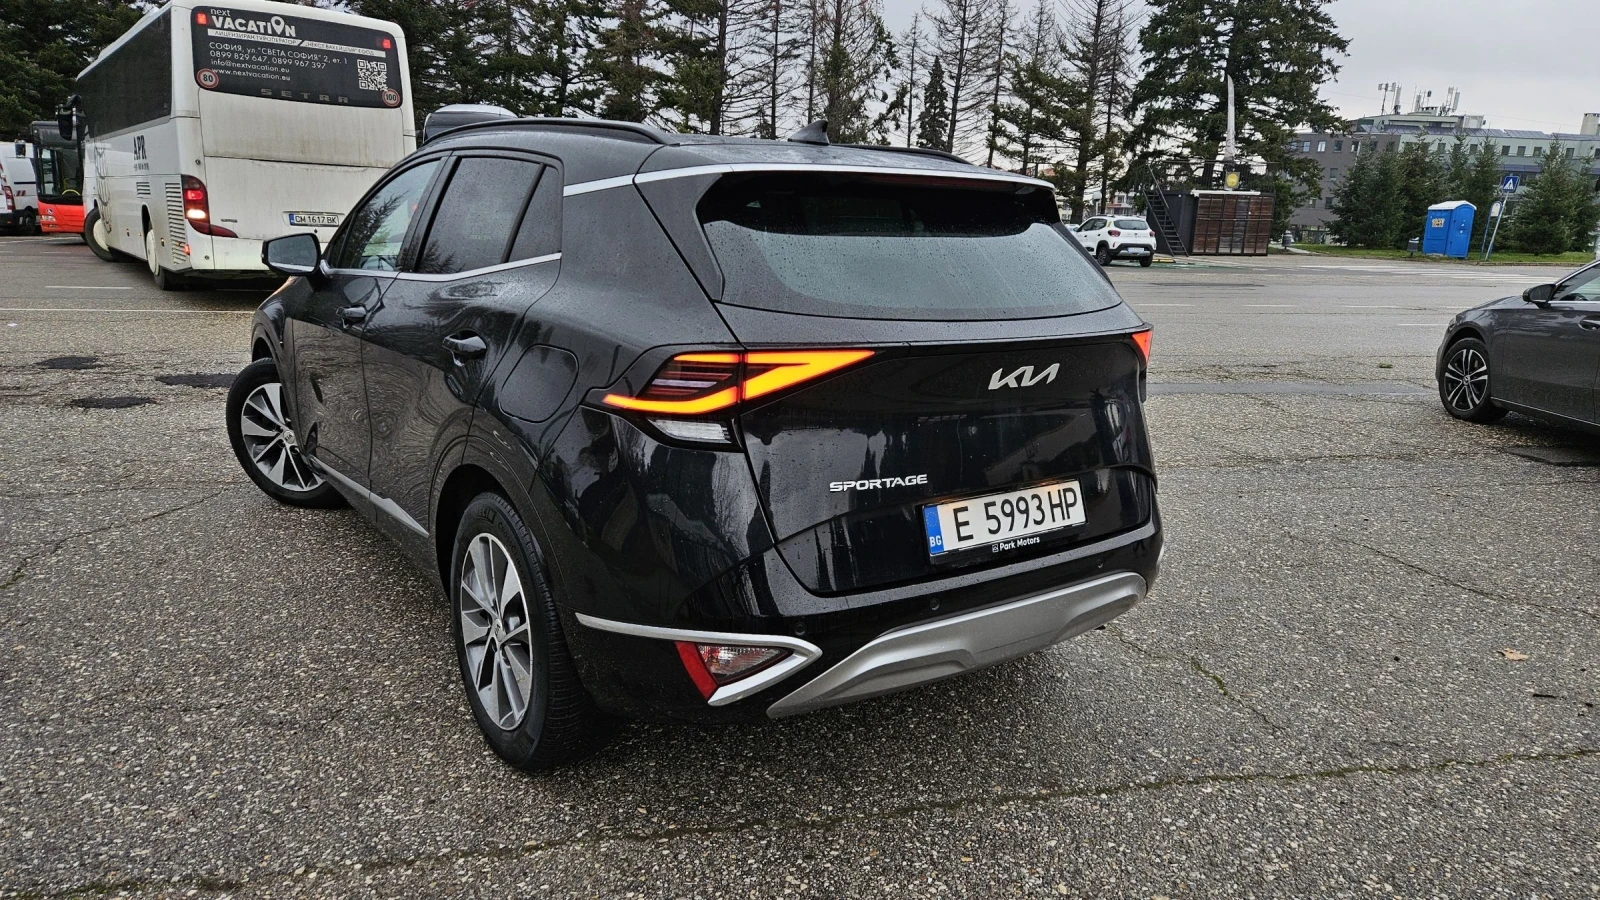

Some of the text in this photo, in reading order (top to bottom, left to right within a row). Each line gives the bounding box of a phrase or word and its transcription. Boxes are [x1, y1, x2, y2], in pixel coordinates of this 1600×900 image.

[210, 8, 231, 17] next
[211, 15, 296, 37] VACATION
[209, 50, 232, 58] 0899
[233, 52, 250, 60] 829
[271, 57, 293, 65] 0899
[294, 59, 309, 67] 967
[311, 61, 326, 70] 397
[210, 58, 290, 73] info@nextvacation.eu
[202, 73, 214, 83] 80
[212, 68, 291, 81] www.nextvacation.eu
[294, 215, 338, 224] CM 1617 BK
[988, 363, 1060, 390] KIA
[829, 474, 928, 492] SPORTAGE
[953, 506, 974, 542] E
[930, 536, 942, 548] BG
[999, 536, 1040, 551] Park Motors
